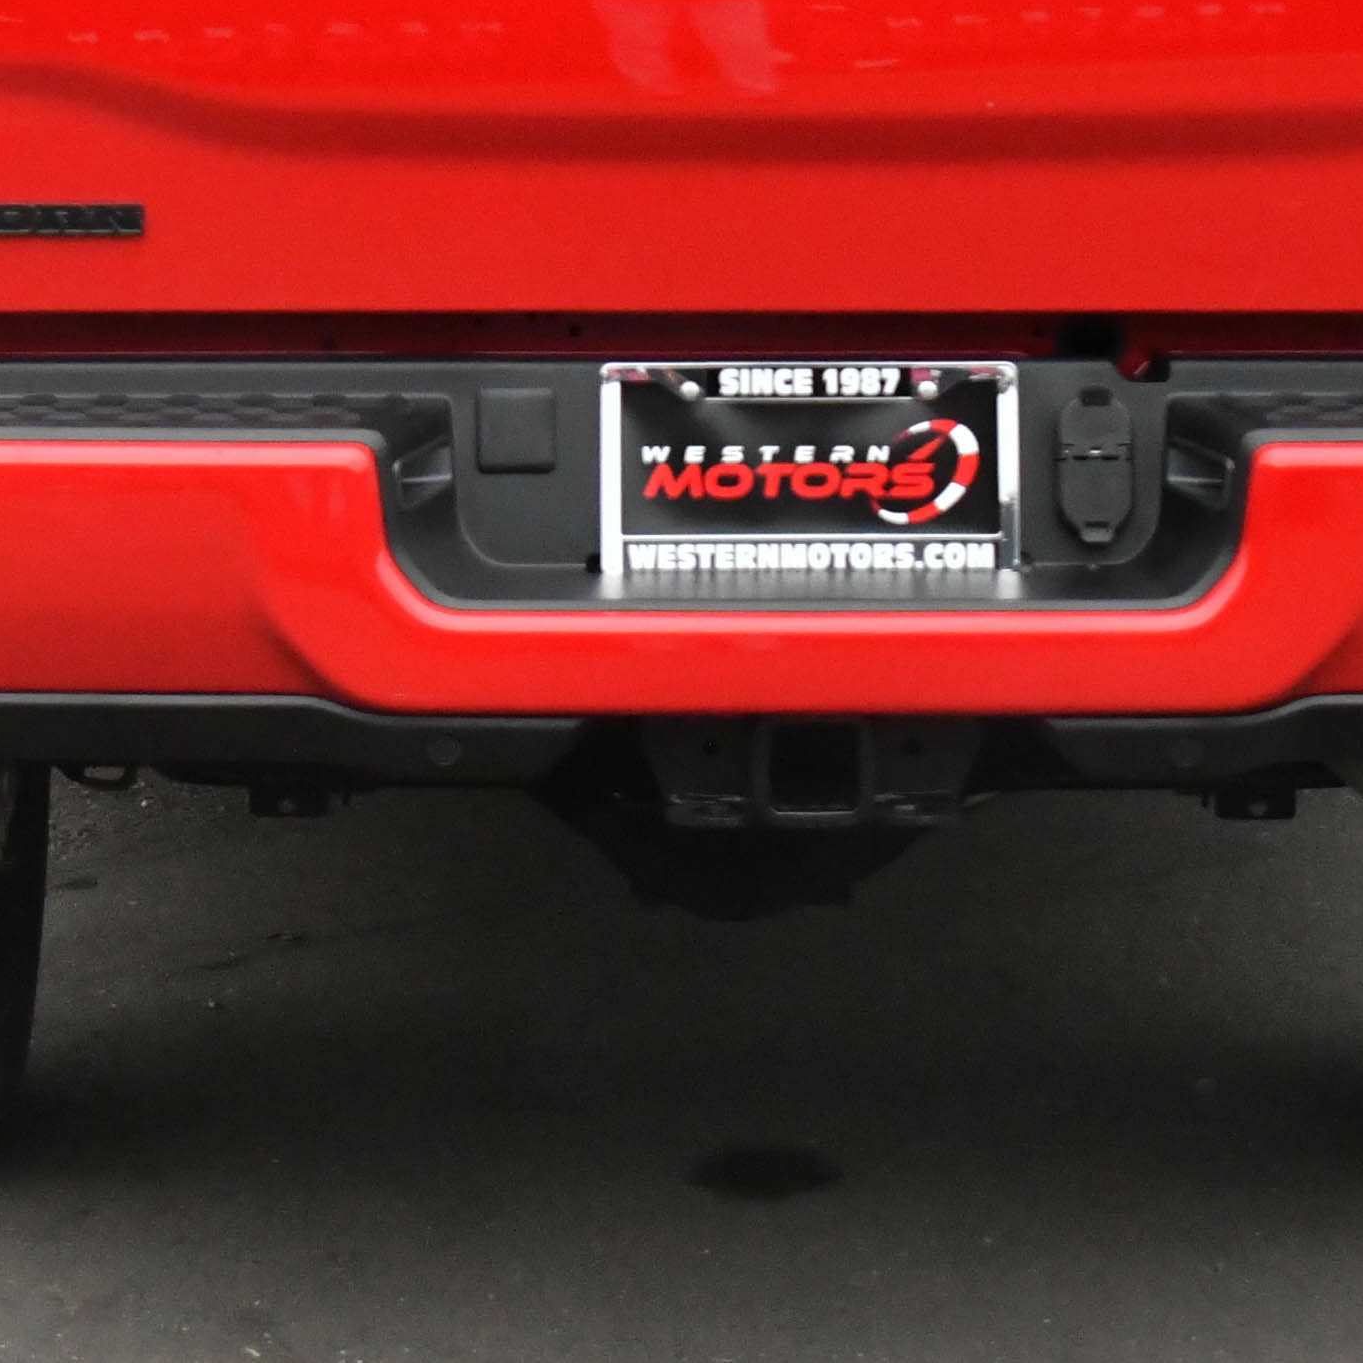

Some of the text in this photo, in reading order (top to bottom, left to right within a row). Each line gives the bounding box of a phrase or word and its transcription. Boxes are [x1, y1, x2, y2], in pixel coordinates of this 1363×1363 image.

[718, 367, 901, 397] SINCE 1987
[641, 445, 891, 464] WESTERN
[642, 462, 936, 500] MOTORS
[628, 543, 996, 570] WESTERNMOTORS.COM
